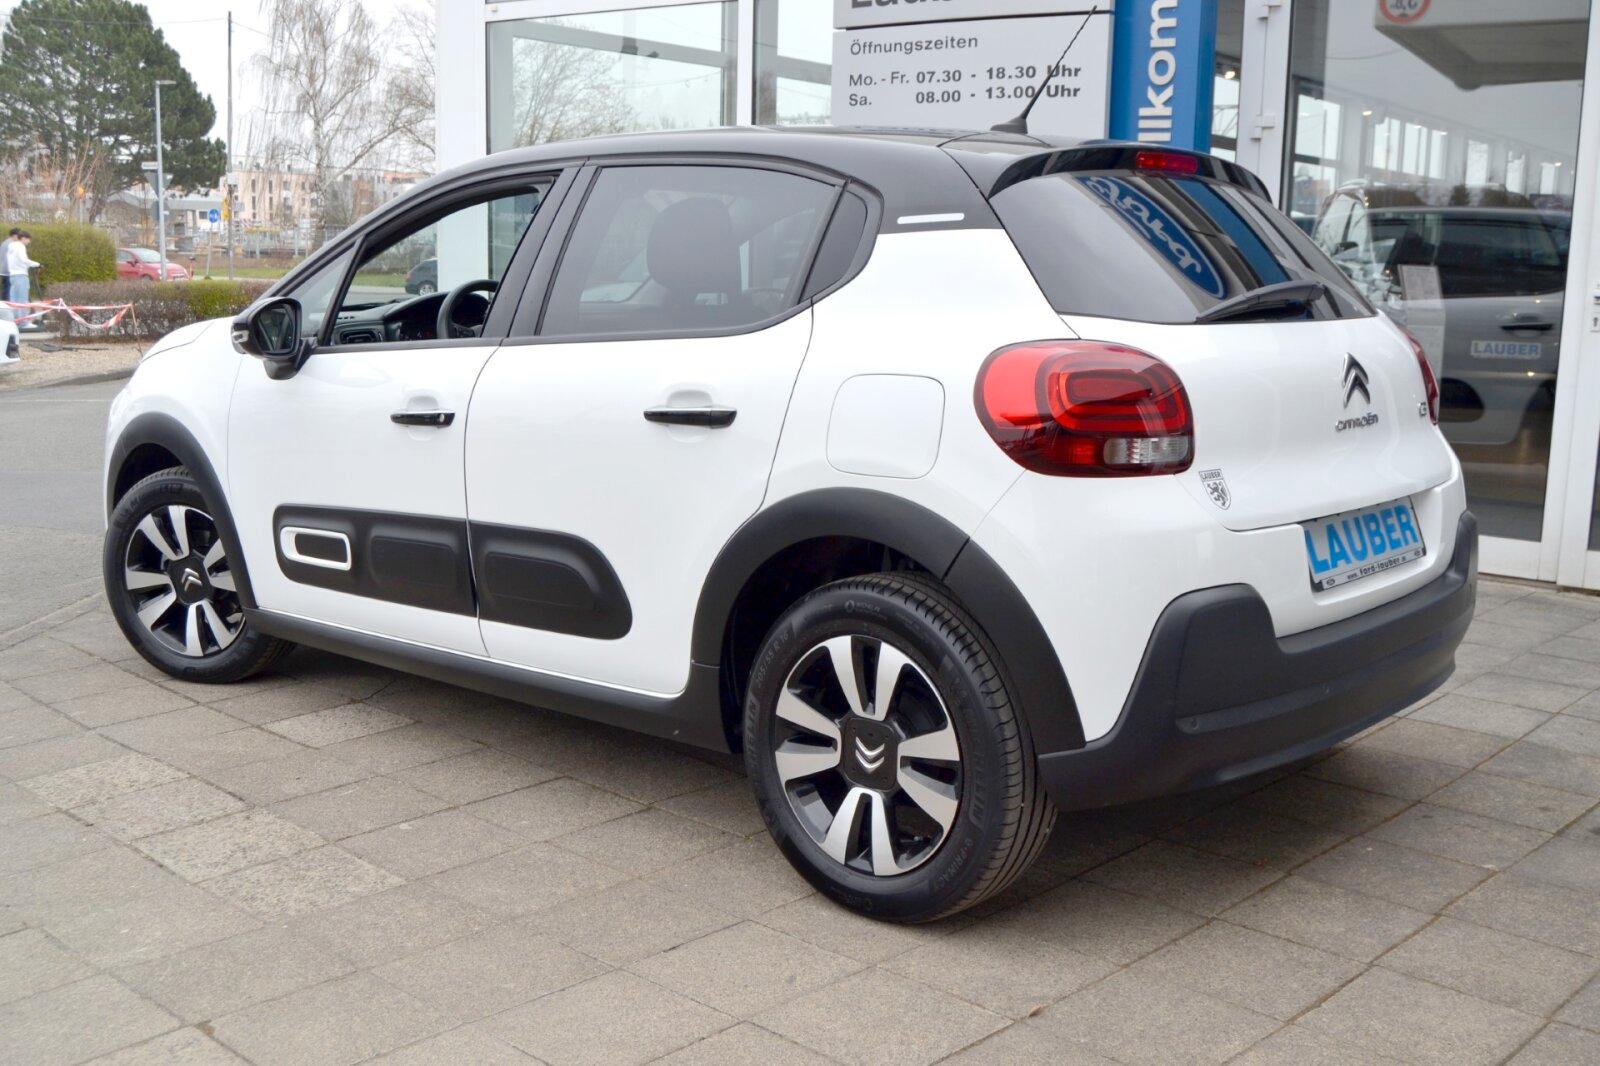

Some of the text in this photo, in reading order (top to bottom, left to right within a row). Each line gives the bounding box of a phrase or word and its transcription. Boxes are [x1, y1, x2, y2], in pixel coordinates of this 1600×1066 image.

[850, 36, 978, 56] Öffnungszeiten
[849, 73, 877, 87] Mo.
[890, 71, 909, 84] Fr.
[916, 69, 962, 84] 07.30
[986, 65, 1036, 80] 18.30
[1046, 64, 1081, 78] Uhr
[848, 93, 872, 107] Sa.
[915, 90, 961, 104] 08.00
[985, 85, 1036, 99] 13.00
[1046, 84, 1081, 98] Uhr
[1473, 342, 1540, 356] LAUBER
[1200, 470, 1221, 480] LAUBER
[1304, 504, 1419, 575] LAUBER
